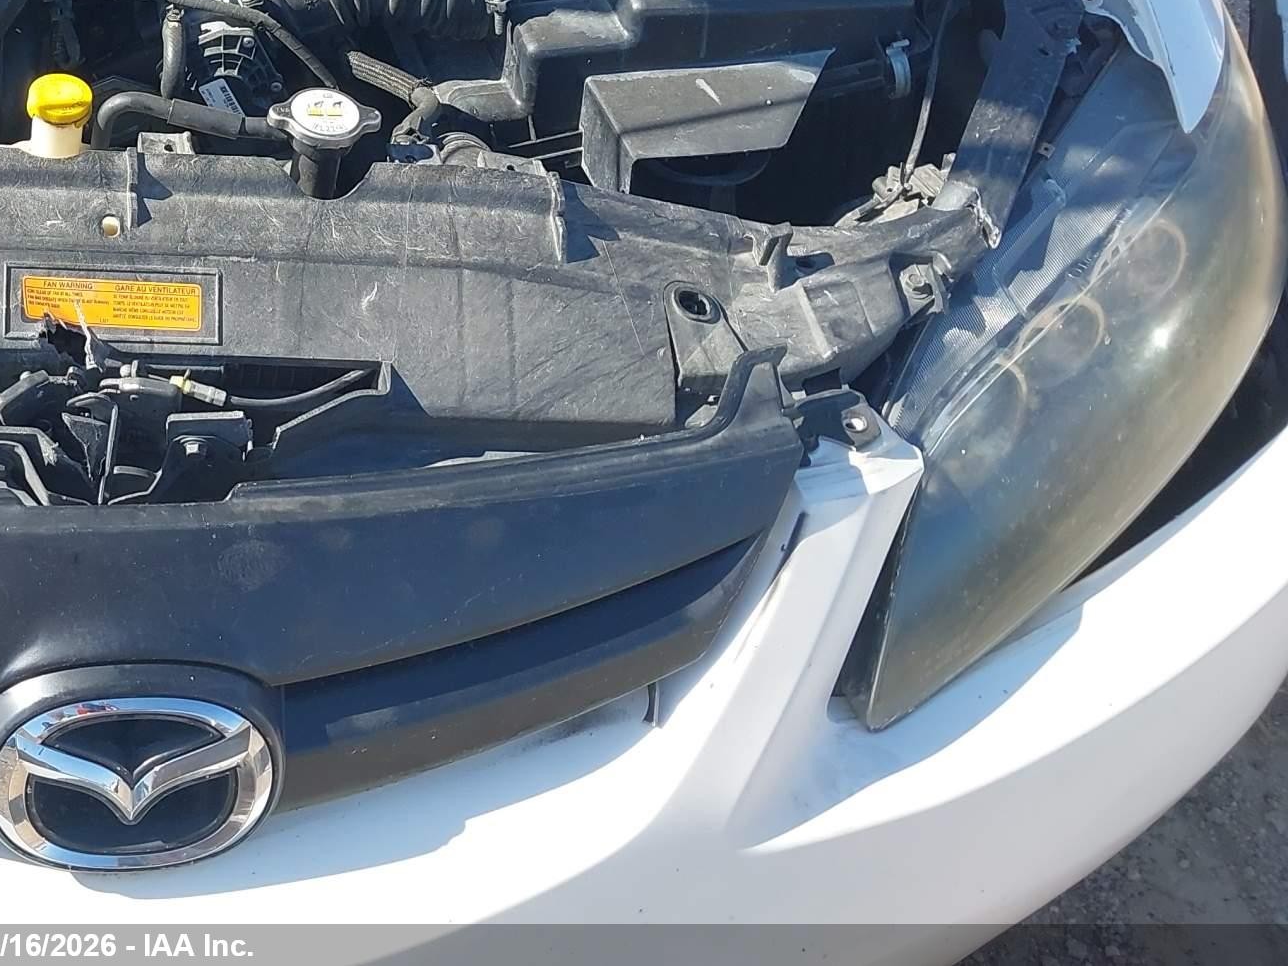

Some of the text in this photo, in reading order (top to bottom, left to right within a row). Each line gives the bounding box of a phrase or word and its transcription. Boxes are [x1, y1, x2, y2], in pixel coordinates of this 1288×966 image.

[59, 281, 93, 289] WARNING
[114, 284, 134, 292] GARE
[149, 286, 196, 295] VENTILATEUR
